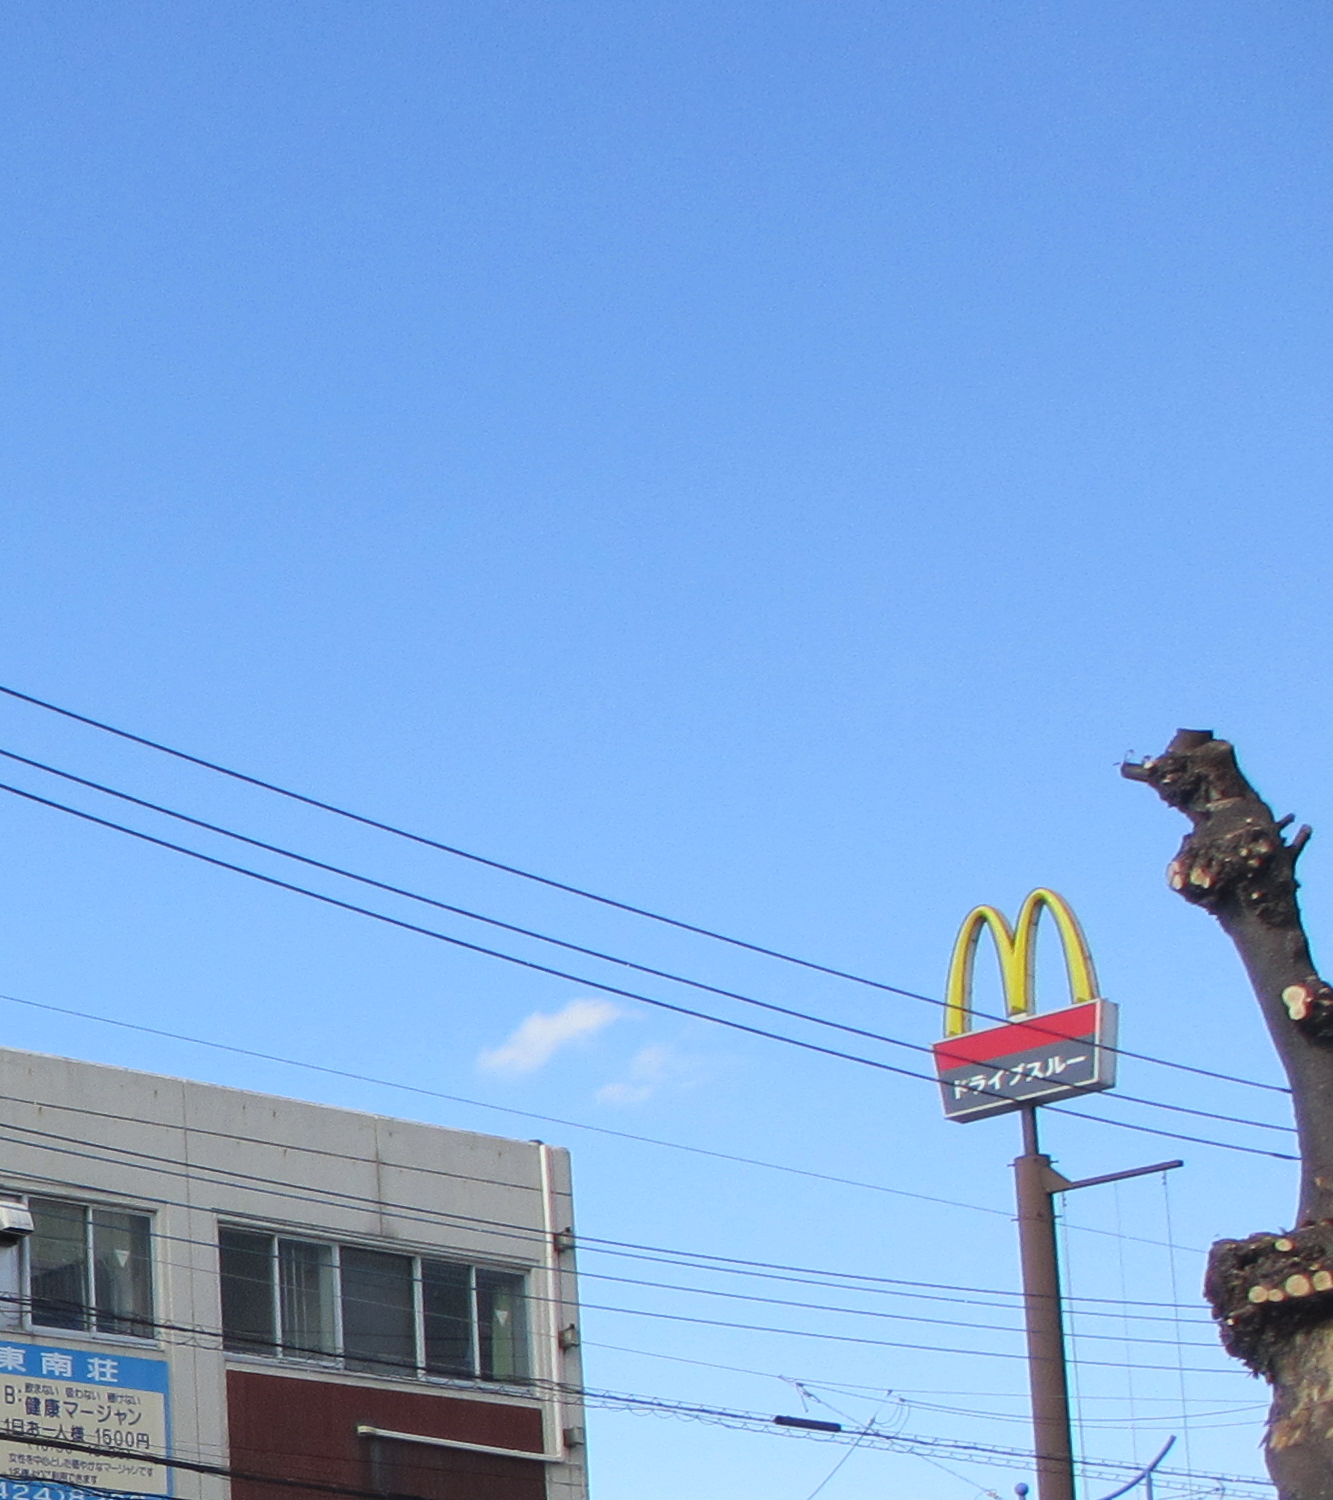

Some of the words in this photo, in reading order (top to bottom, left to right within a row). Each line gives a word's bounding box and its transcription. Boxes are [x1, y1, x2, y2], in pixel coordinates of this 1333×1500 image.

[953, 1054, 1088, 1100] ドライブスルー
[95, 1427, 150, 1450] 1500円
